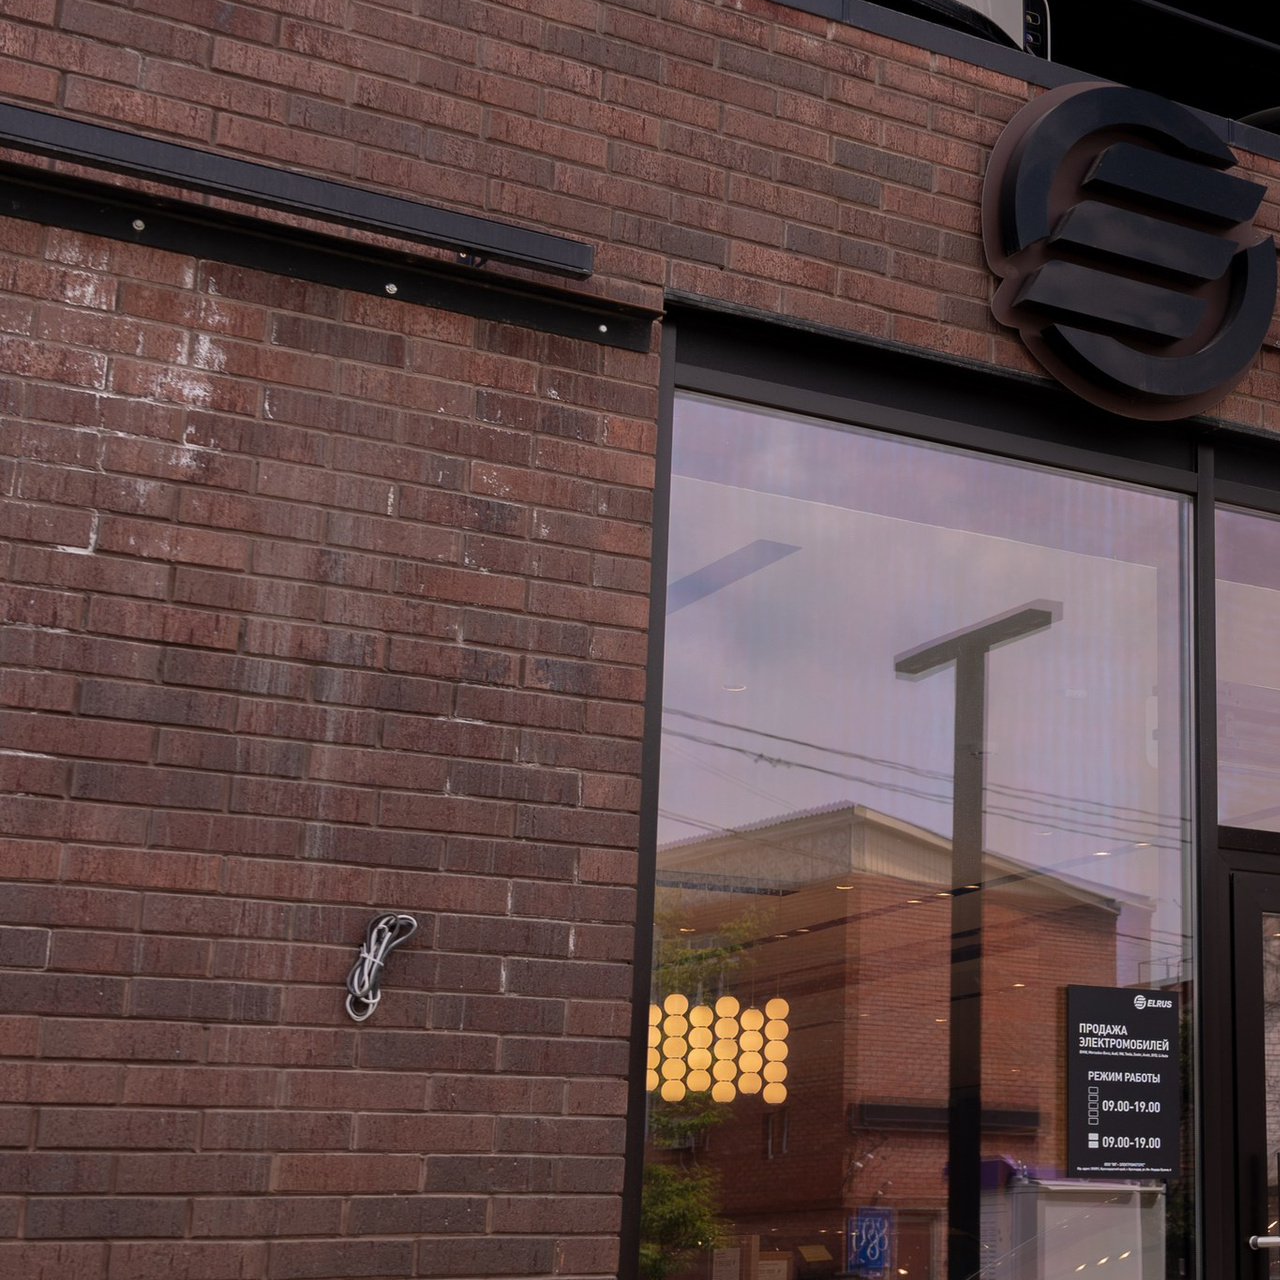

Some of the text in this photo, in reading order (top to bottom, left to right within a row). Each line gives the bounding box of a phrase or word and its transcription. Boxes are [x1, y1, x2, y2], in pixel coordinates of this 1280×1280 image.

[1146, 999, 1173, 1009] ELRUS
[1078, 1022, 1128, 1036] ПРОДАЖА
[1078, 1037, 1170, 1051] ЭЛЕКТРОМОБИЛЕЙ
[1088, 1071, 1161, 1084] РЕЖИМ РАБОТЫ
[1102, 1100, 1161, 1113] 09.00-19.00
[1102, 1137, 1161, 1149] 09.00-19.00
